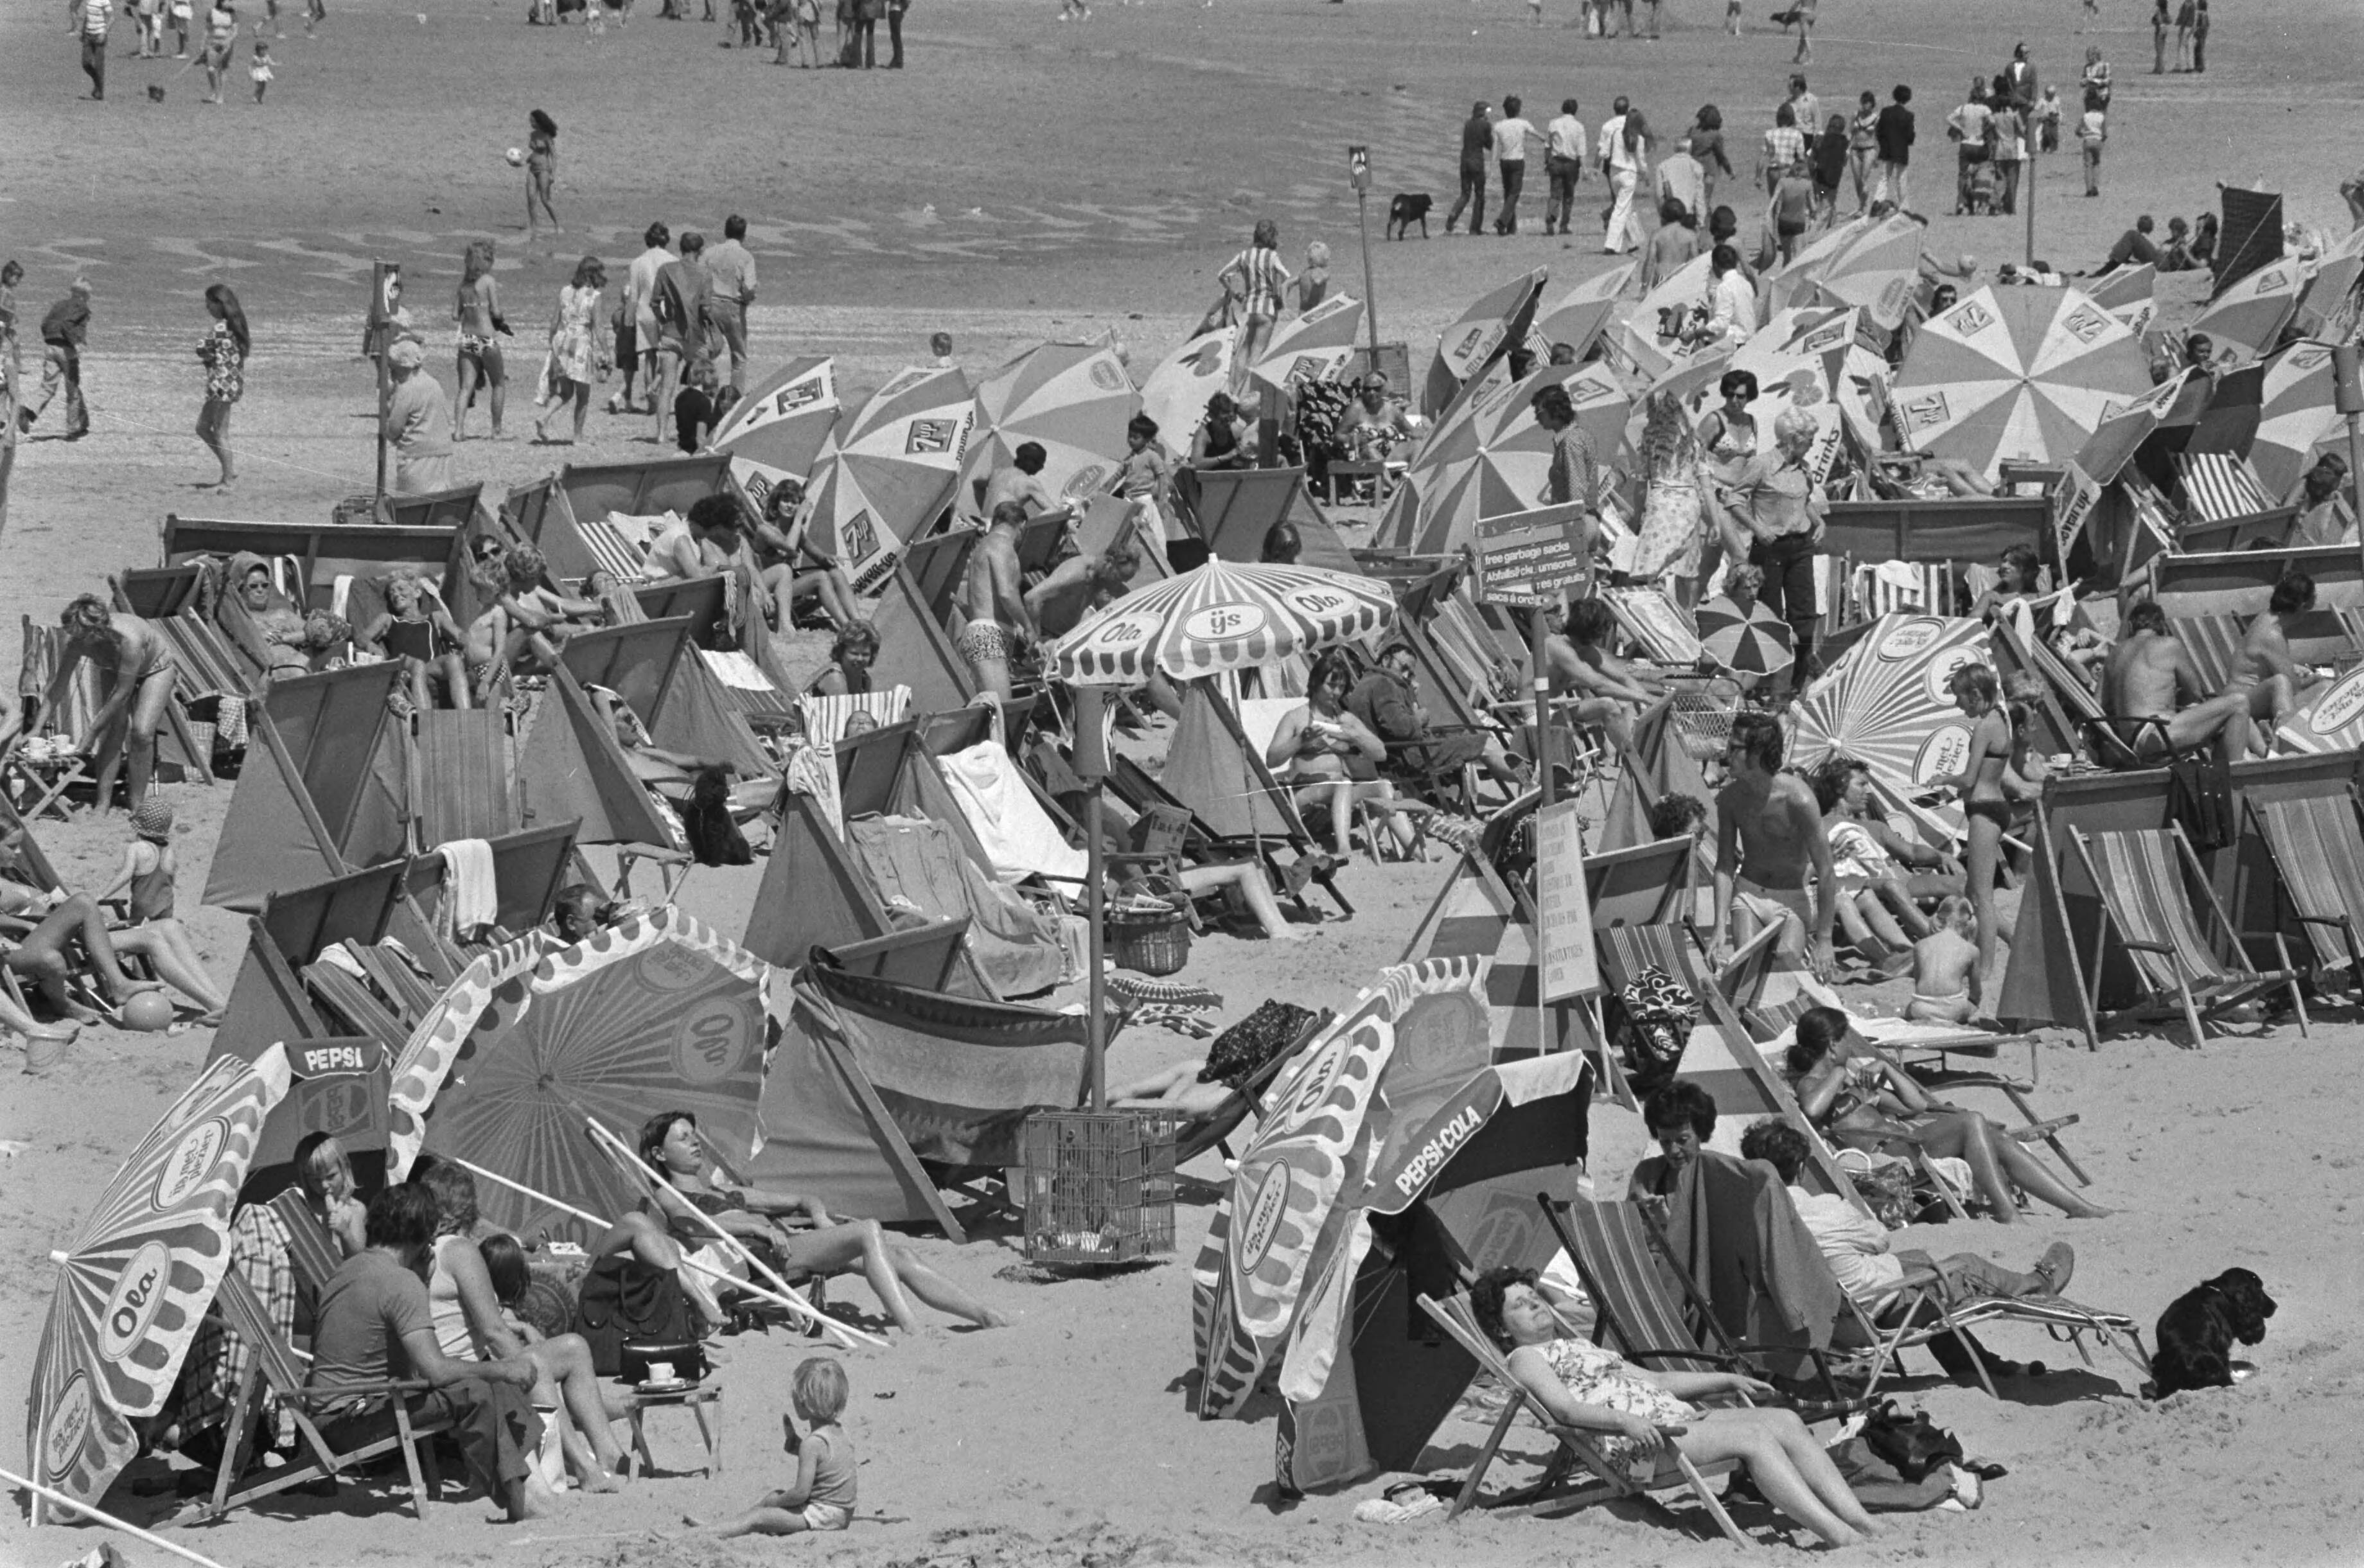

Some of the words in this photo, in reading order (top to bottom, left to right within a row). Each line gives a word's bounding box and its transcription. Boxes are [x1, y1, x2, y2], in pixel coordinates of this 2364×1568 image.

[912, 423, 942, 452] 7up
[1813, 428, 1840, 484] drinks
[845, 521, 869, 558] 7up
[1485, 554, 1504, 565] free
[1504, 548, 1542, 564] garbage
[1543, 542, 1570, 554] sacks
[1486, 565, 1535, 583] Abfallsck
[1539, 557, 1577, 572] umsonst
[1295, 592, 1343, 613] Ola
[1101, 622, 1143, 642] Ola
[1936, 737, 1953, 771] met
[1943, 738, 1964, 776] lezier
[304, 1046, 364, 1071] PEPSI
[1296, 1052, 1337, 1113] Ola
[168, 1175, 189, 1199] ijs
[179, 1138, 198, 1177] met
[188, 1129, 214, 1181] plezier
[111, 1267, 157, 1339] Ola
